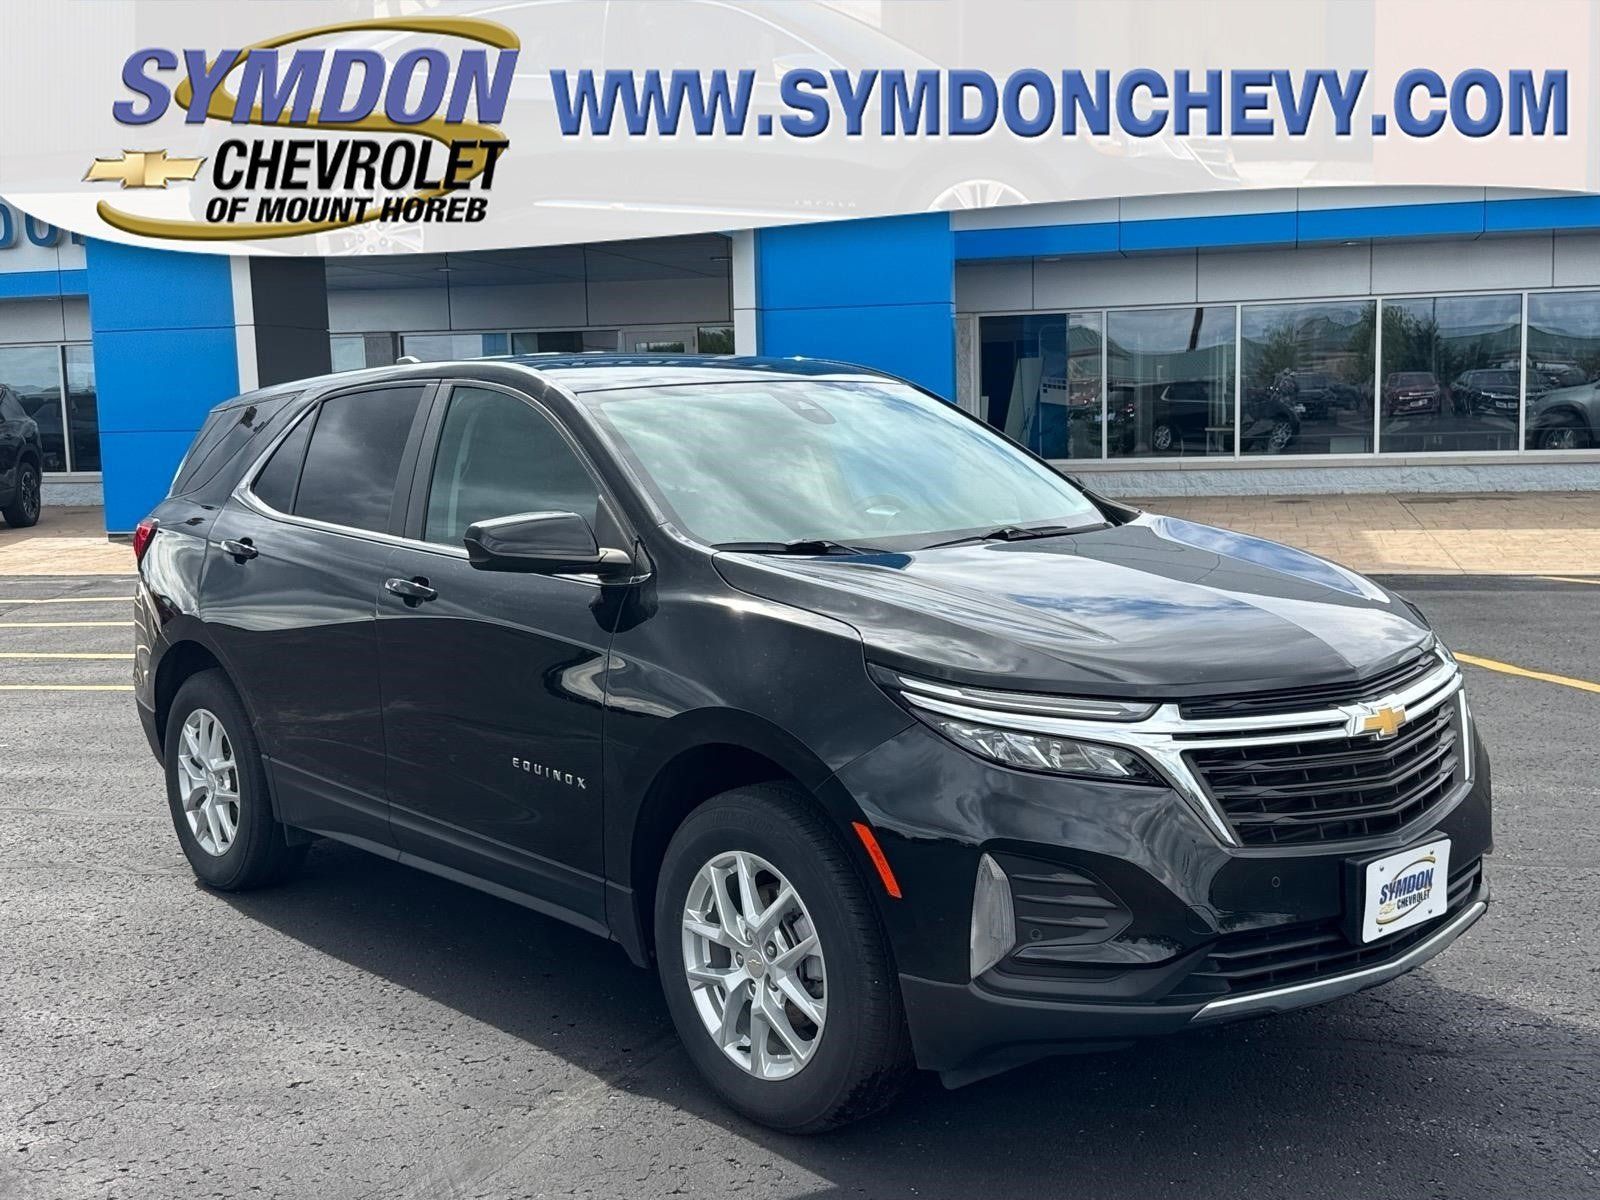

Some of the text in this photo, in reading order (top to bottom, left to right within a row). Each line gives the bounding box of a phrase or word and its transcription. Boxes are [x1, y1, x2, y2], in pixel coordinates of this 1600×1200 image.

[512, 757, 586, 790] EQUINOX
[1379, 867, 1434, 905] SYMDON
[1397, 889, 1431, 910] CHEVROLET
